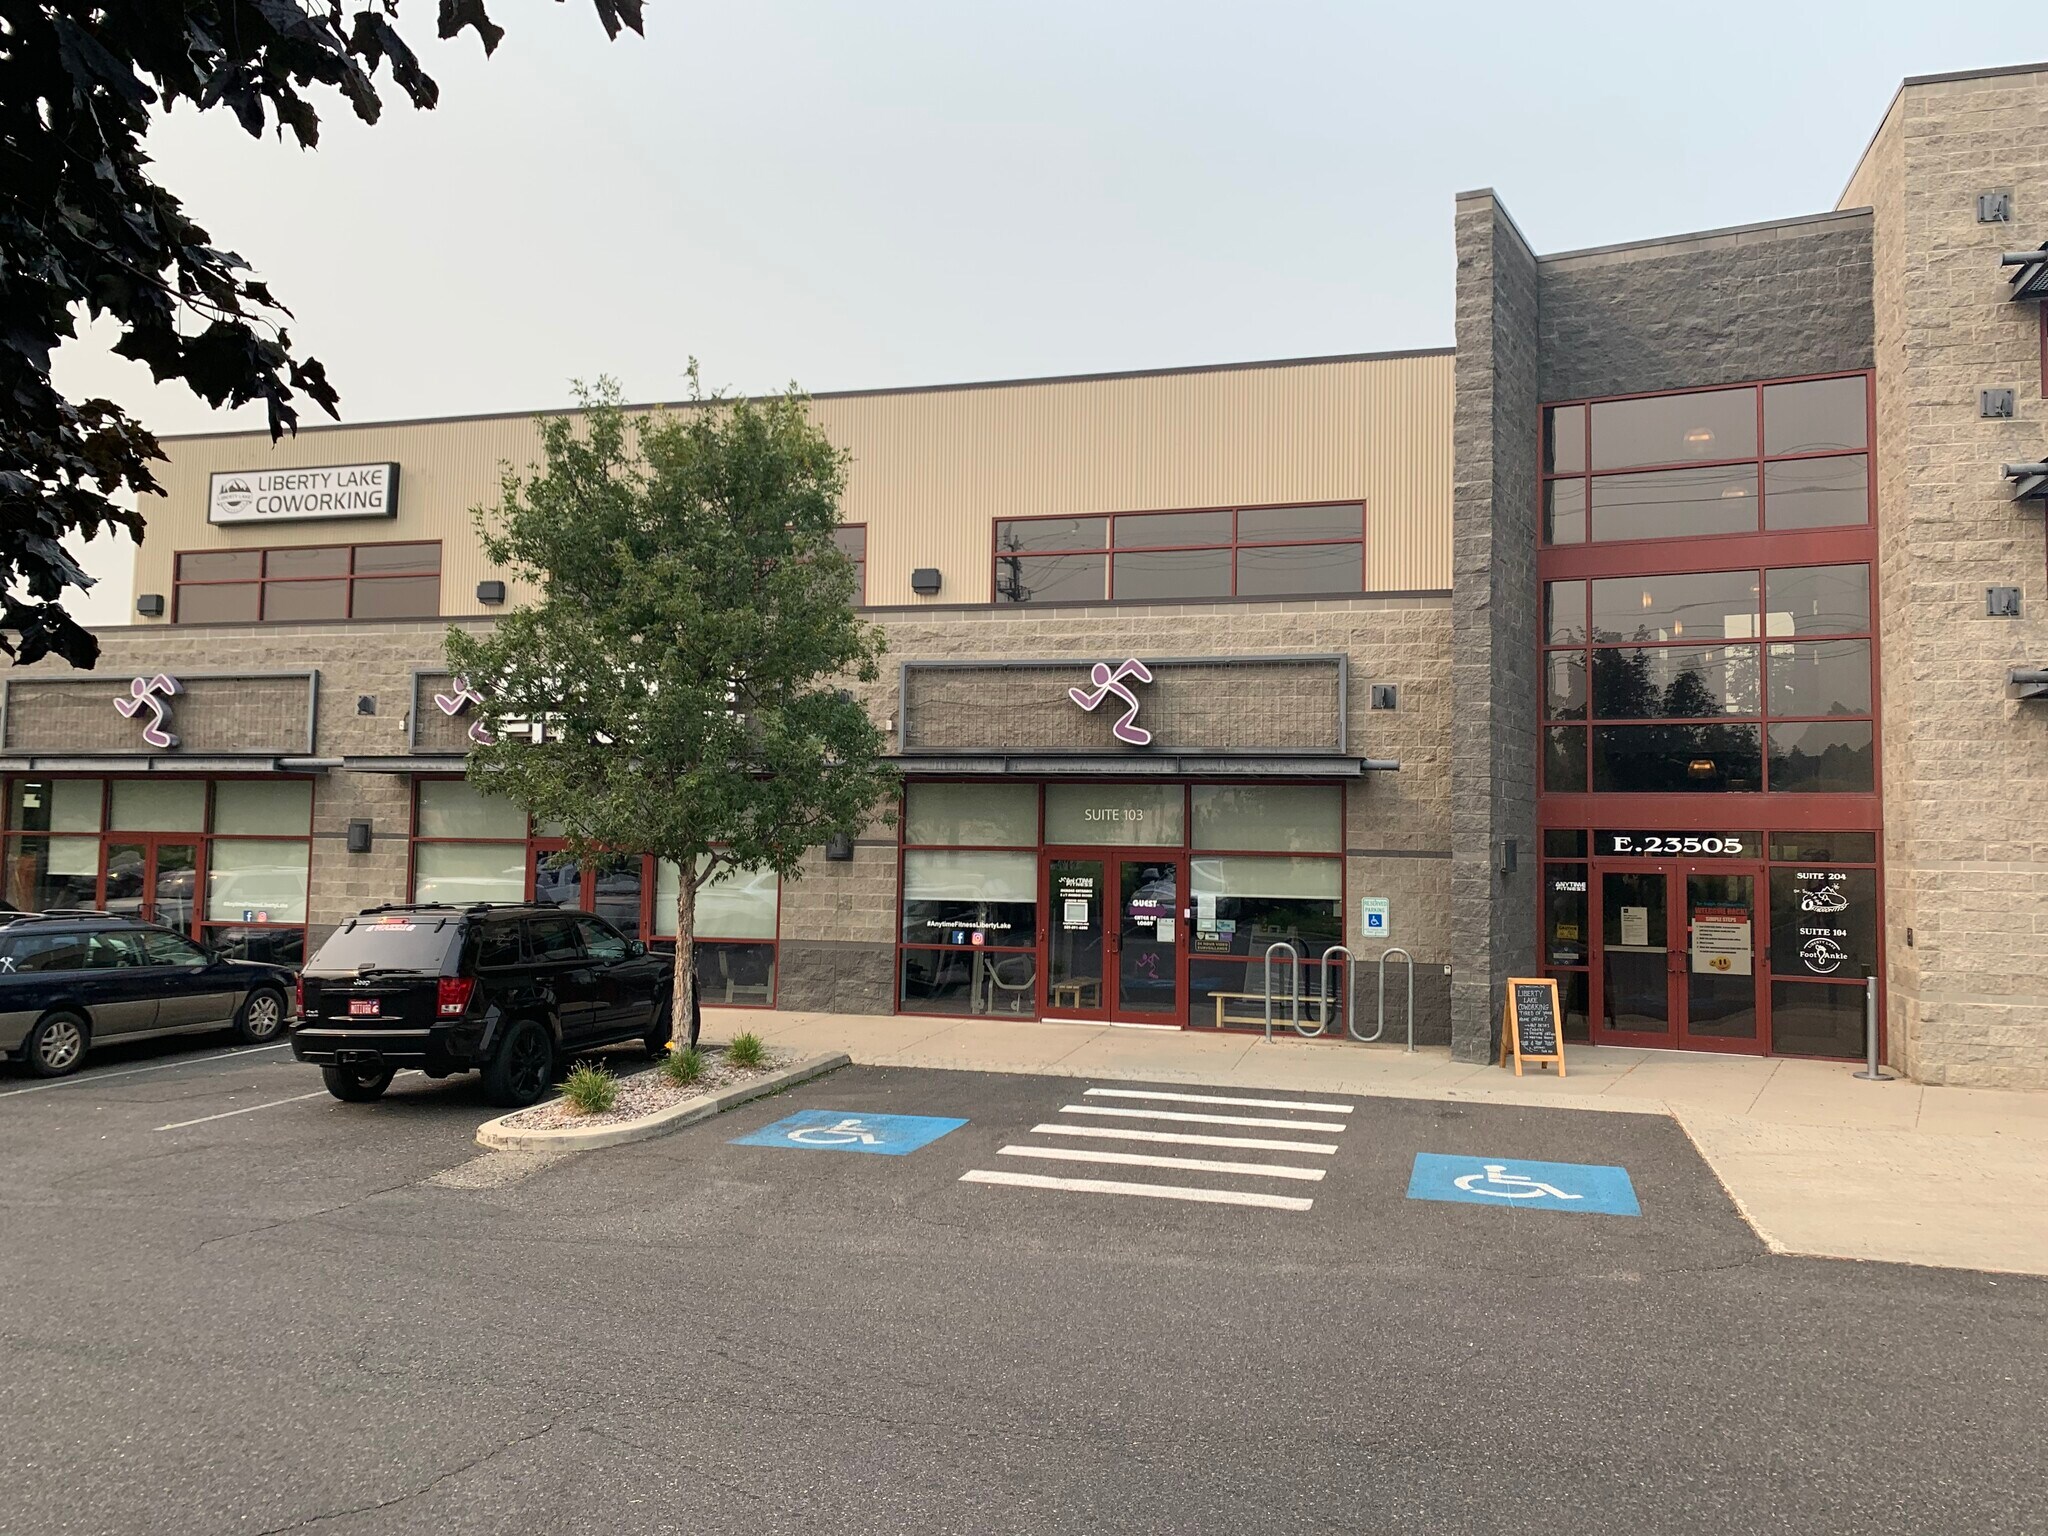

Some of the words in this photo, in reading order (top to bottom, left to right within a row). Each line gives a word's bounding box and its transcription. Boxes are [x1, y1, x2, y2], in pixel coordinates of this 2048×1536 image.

[258, 473, 332, 492] LIBERTY
[337, 470, 383, 487] LAKE
[256, 491, 383, 514] COWORKING
[1084, 808, 1120, 821] SUITE
[1124, 809, 1144, 821] 103
[1613, 836, 1743, 854] E.23505
[1796, 872, 1825, 880] SUITE
[1132, 899, 1158, 908] GUEST
[926, 920, 1012, 930] #AnytimeFitnessLibertyLake
[1800, 928, 1831, 936] SUITE
[1518, 1004, 1549, 1012] COWORKING
